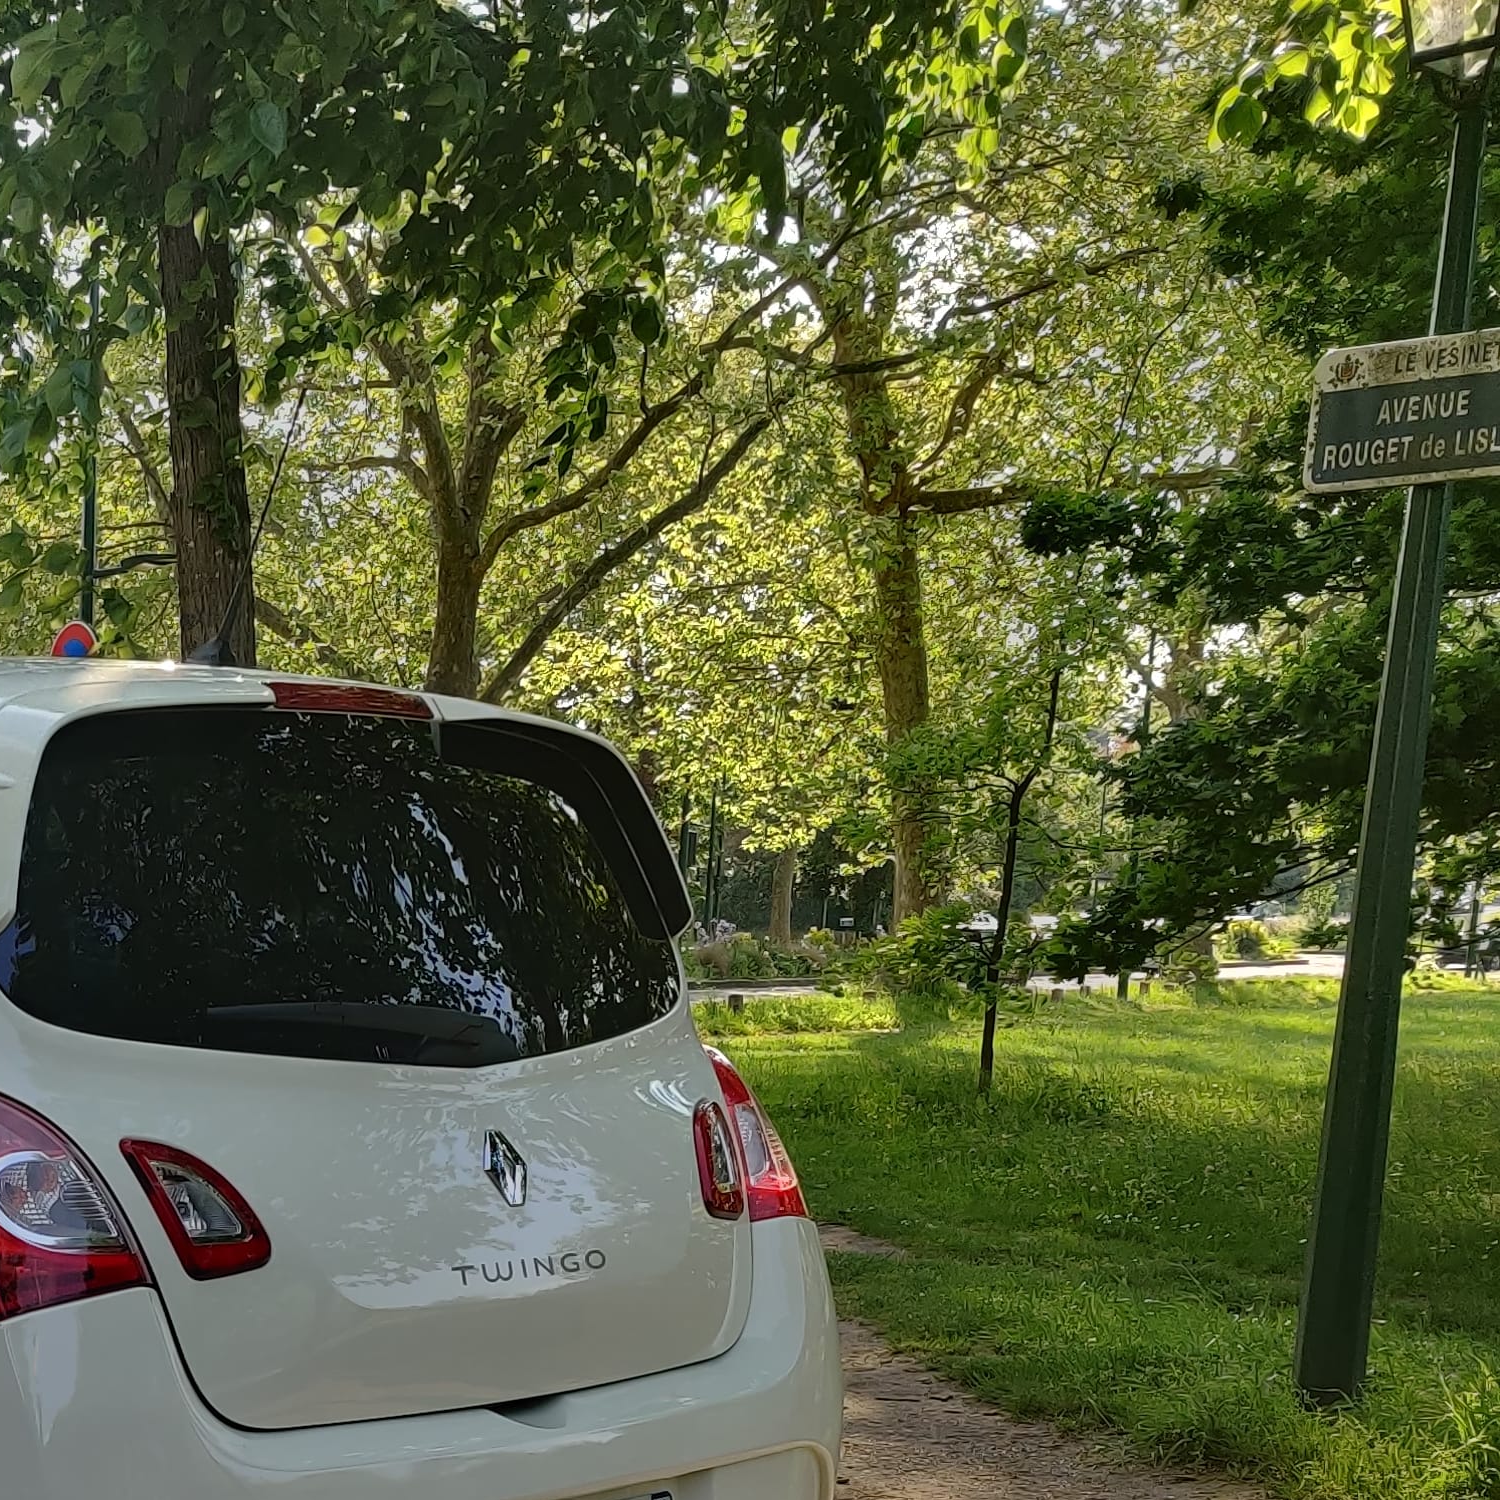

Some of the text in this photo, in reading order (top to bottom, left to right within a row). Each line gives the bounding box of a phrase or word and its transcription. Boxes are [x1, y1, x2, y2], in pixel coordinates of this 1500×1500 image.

[1395, 351, 1417, 373] LE
[1376, 389, 1471, 426] AVENUE
[1322, 435, 1414, 471] ROUGET
[1420, 433, 1445, 460] de
[451, 1250, 606, 1286] TWINGO
